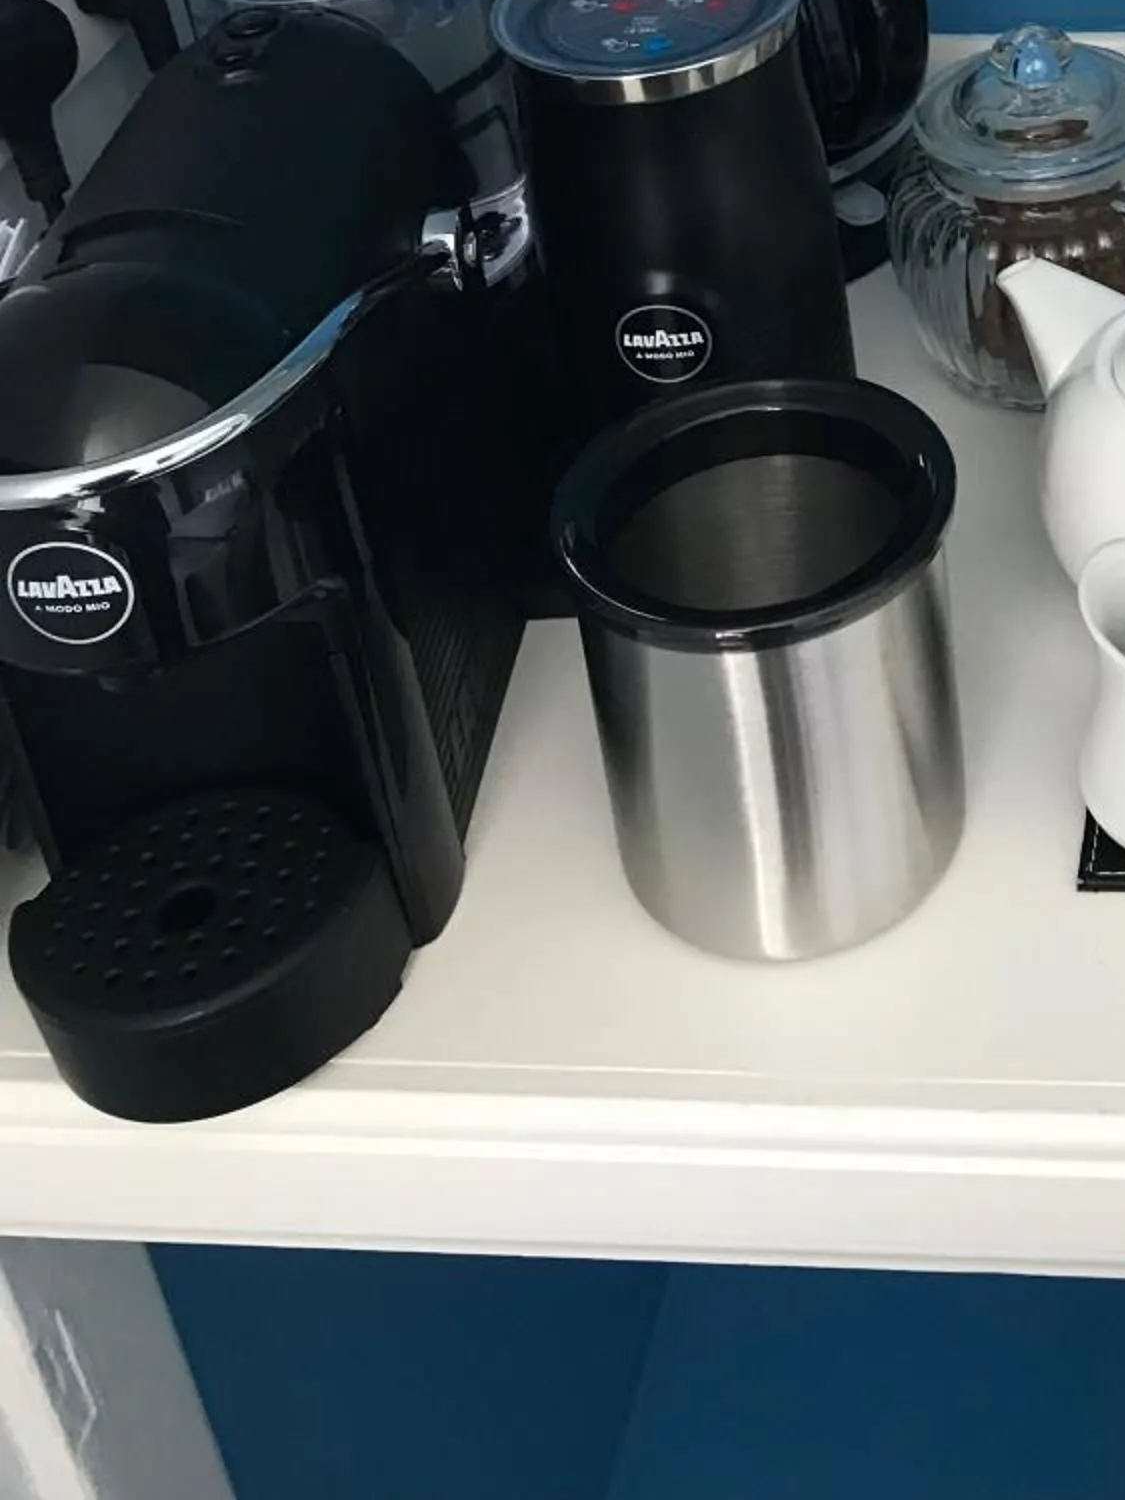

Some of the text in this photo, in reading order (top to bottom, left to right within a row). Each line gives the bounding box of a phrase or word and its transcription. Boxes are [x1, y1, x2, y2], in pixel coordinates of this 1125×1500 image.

[623, 329, 704, 348] LAVAZZA
[17, 575, 122, 598] LAVAZZA
[45, 603, 83, 613] MODO
[85, 601, 110, 612] MIO
